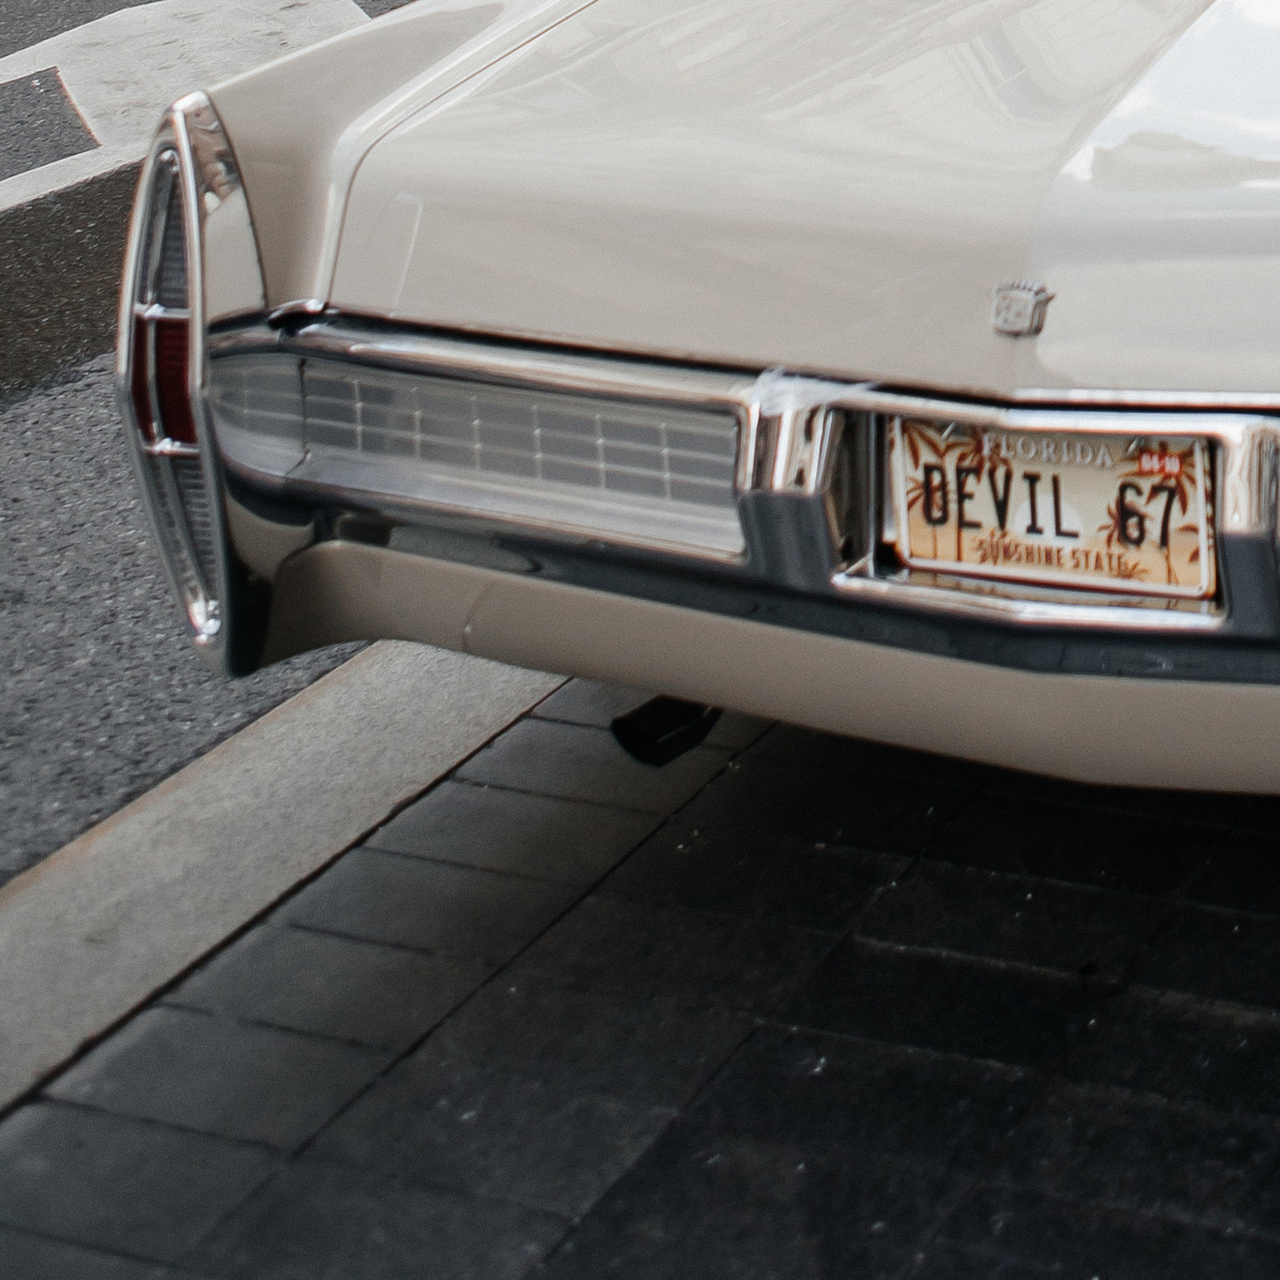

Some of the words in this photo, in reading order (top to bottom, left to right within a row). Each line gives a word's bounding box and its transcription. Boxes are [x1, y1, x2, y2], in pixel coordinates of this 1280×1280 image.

[982, 431, 1114, 469] FLORIDA
[923, 463, 1080, 539] DEVIL
[1117, 481, 1178, 549] 67
[974, 535, 1065, 567] SUNSHINE
[1070, 547, 1125, 577] STATE
